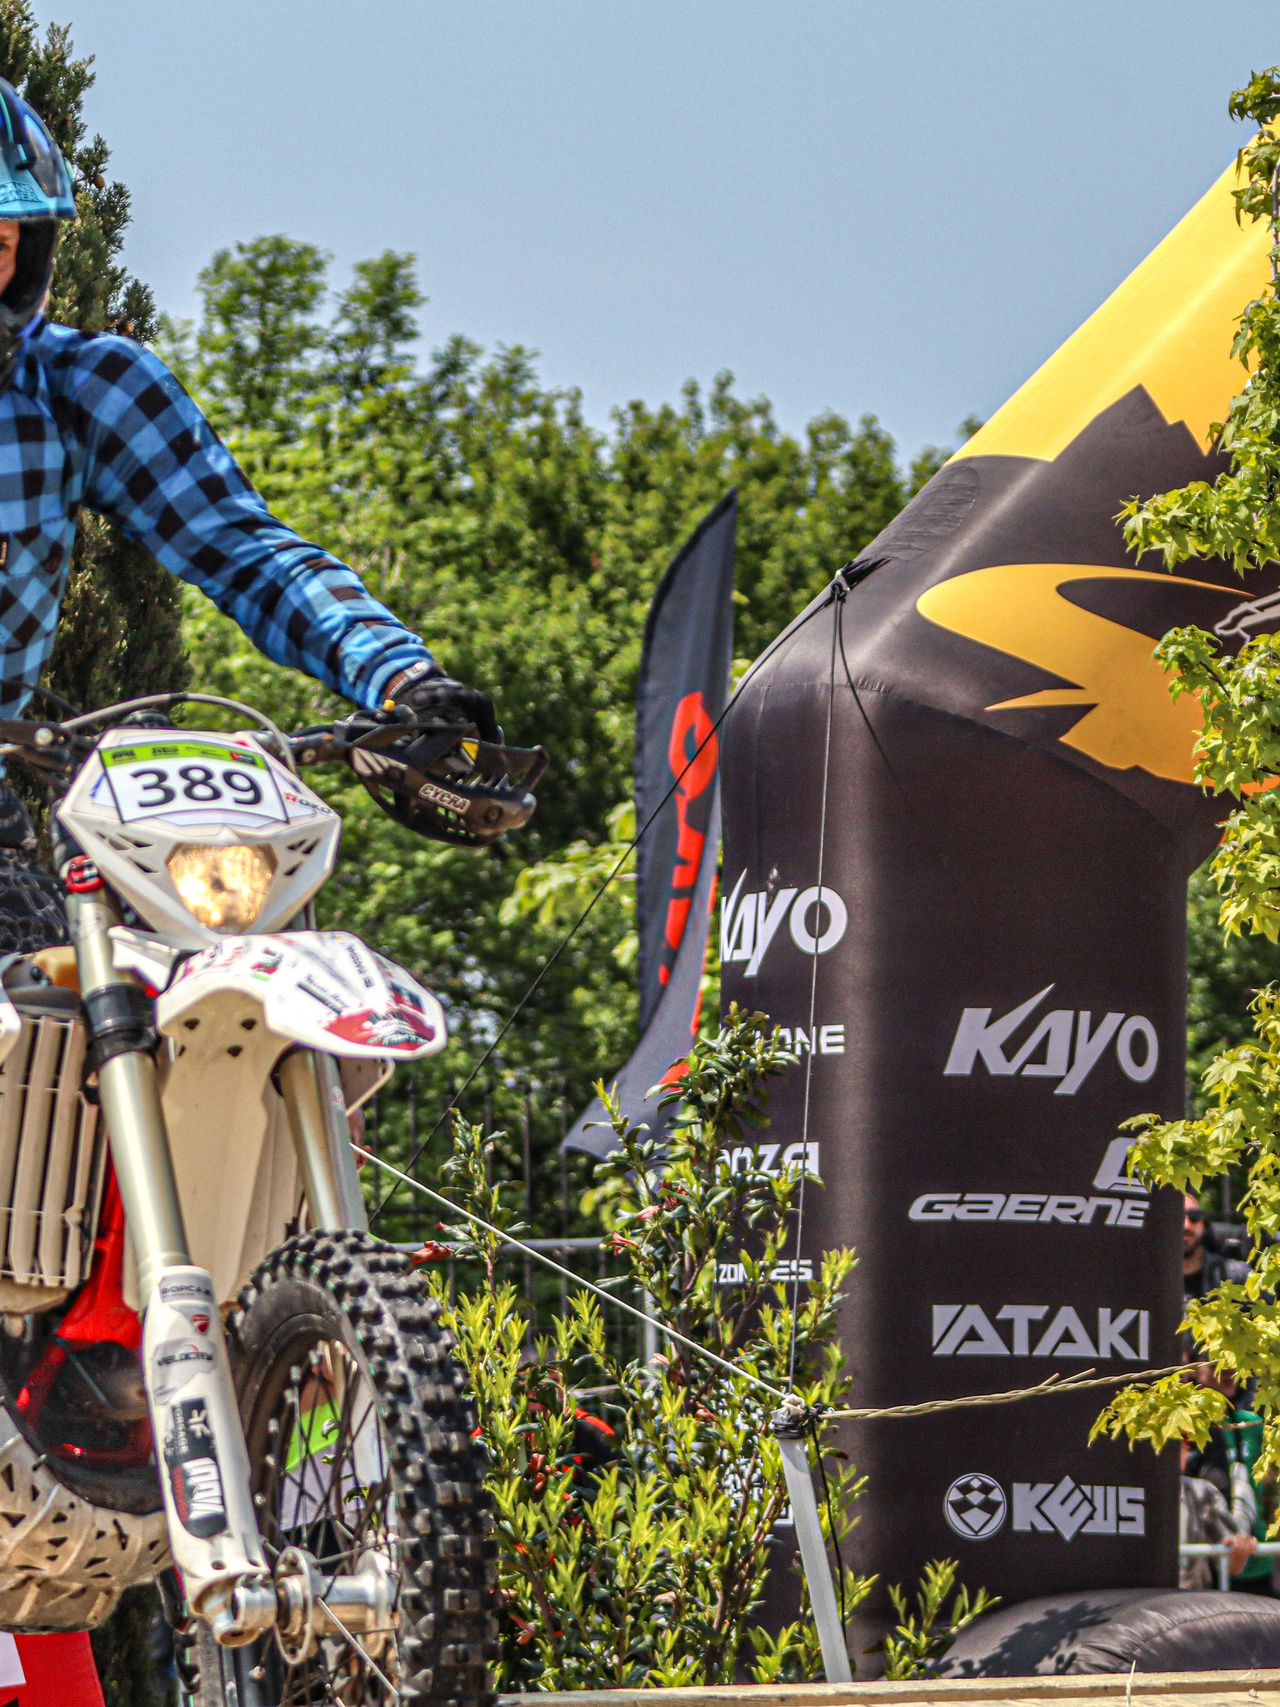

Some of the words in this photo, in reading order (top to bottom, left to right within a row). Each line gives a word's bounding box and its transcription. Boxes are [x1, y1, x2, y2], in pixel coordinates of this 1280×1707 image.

[129, 763, 263, 808] 389
[421, 784, 470, 813] CYCRA
[943, 982, 1159, 1095] KAYO
[718, 1259, 813, 1284] ZONES
[932, 1304, 1149, 1361] ATAKI
